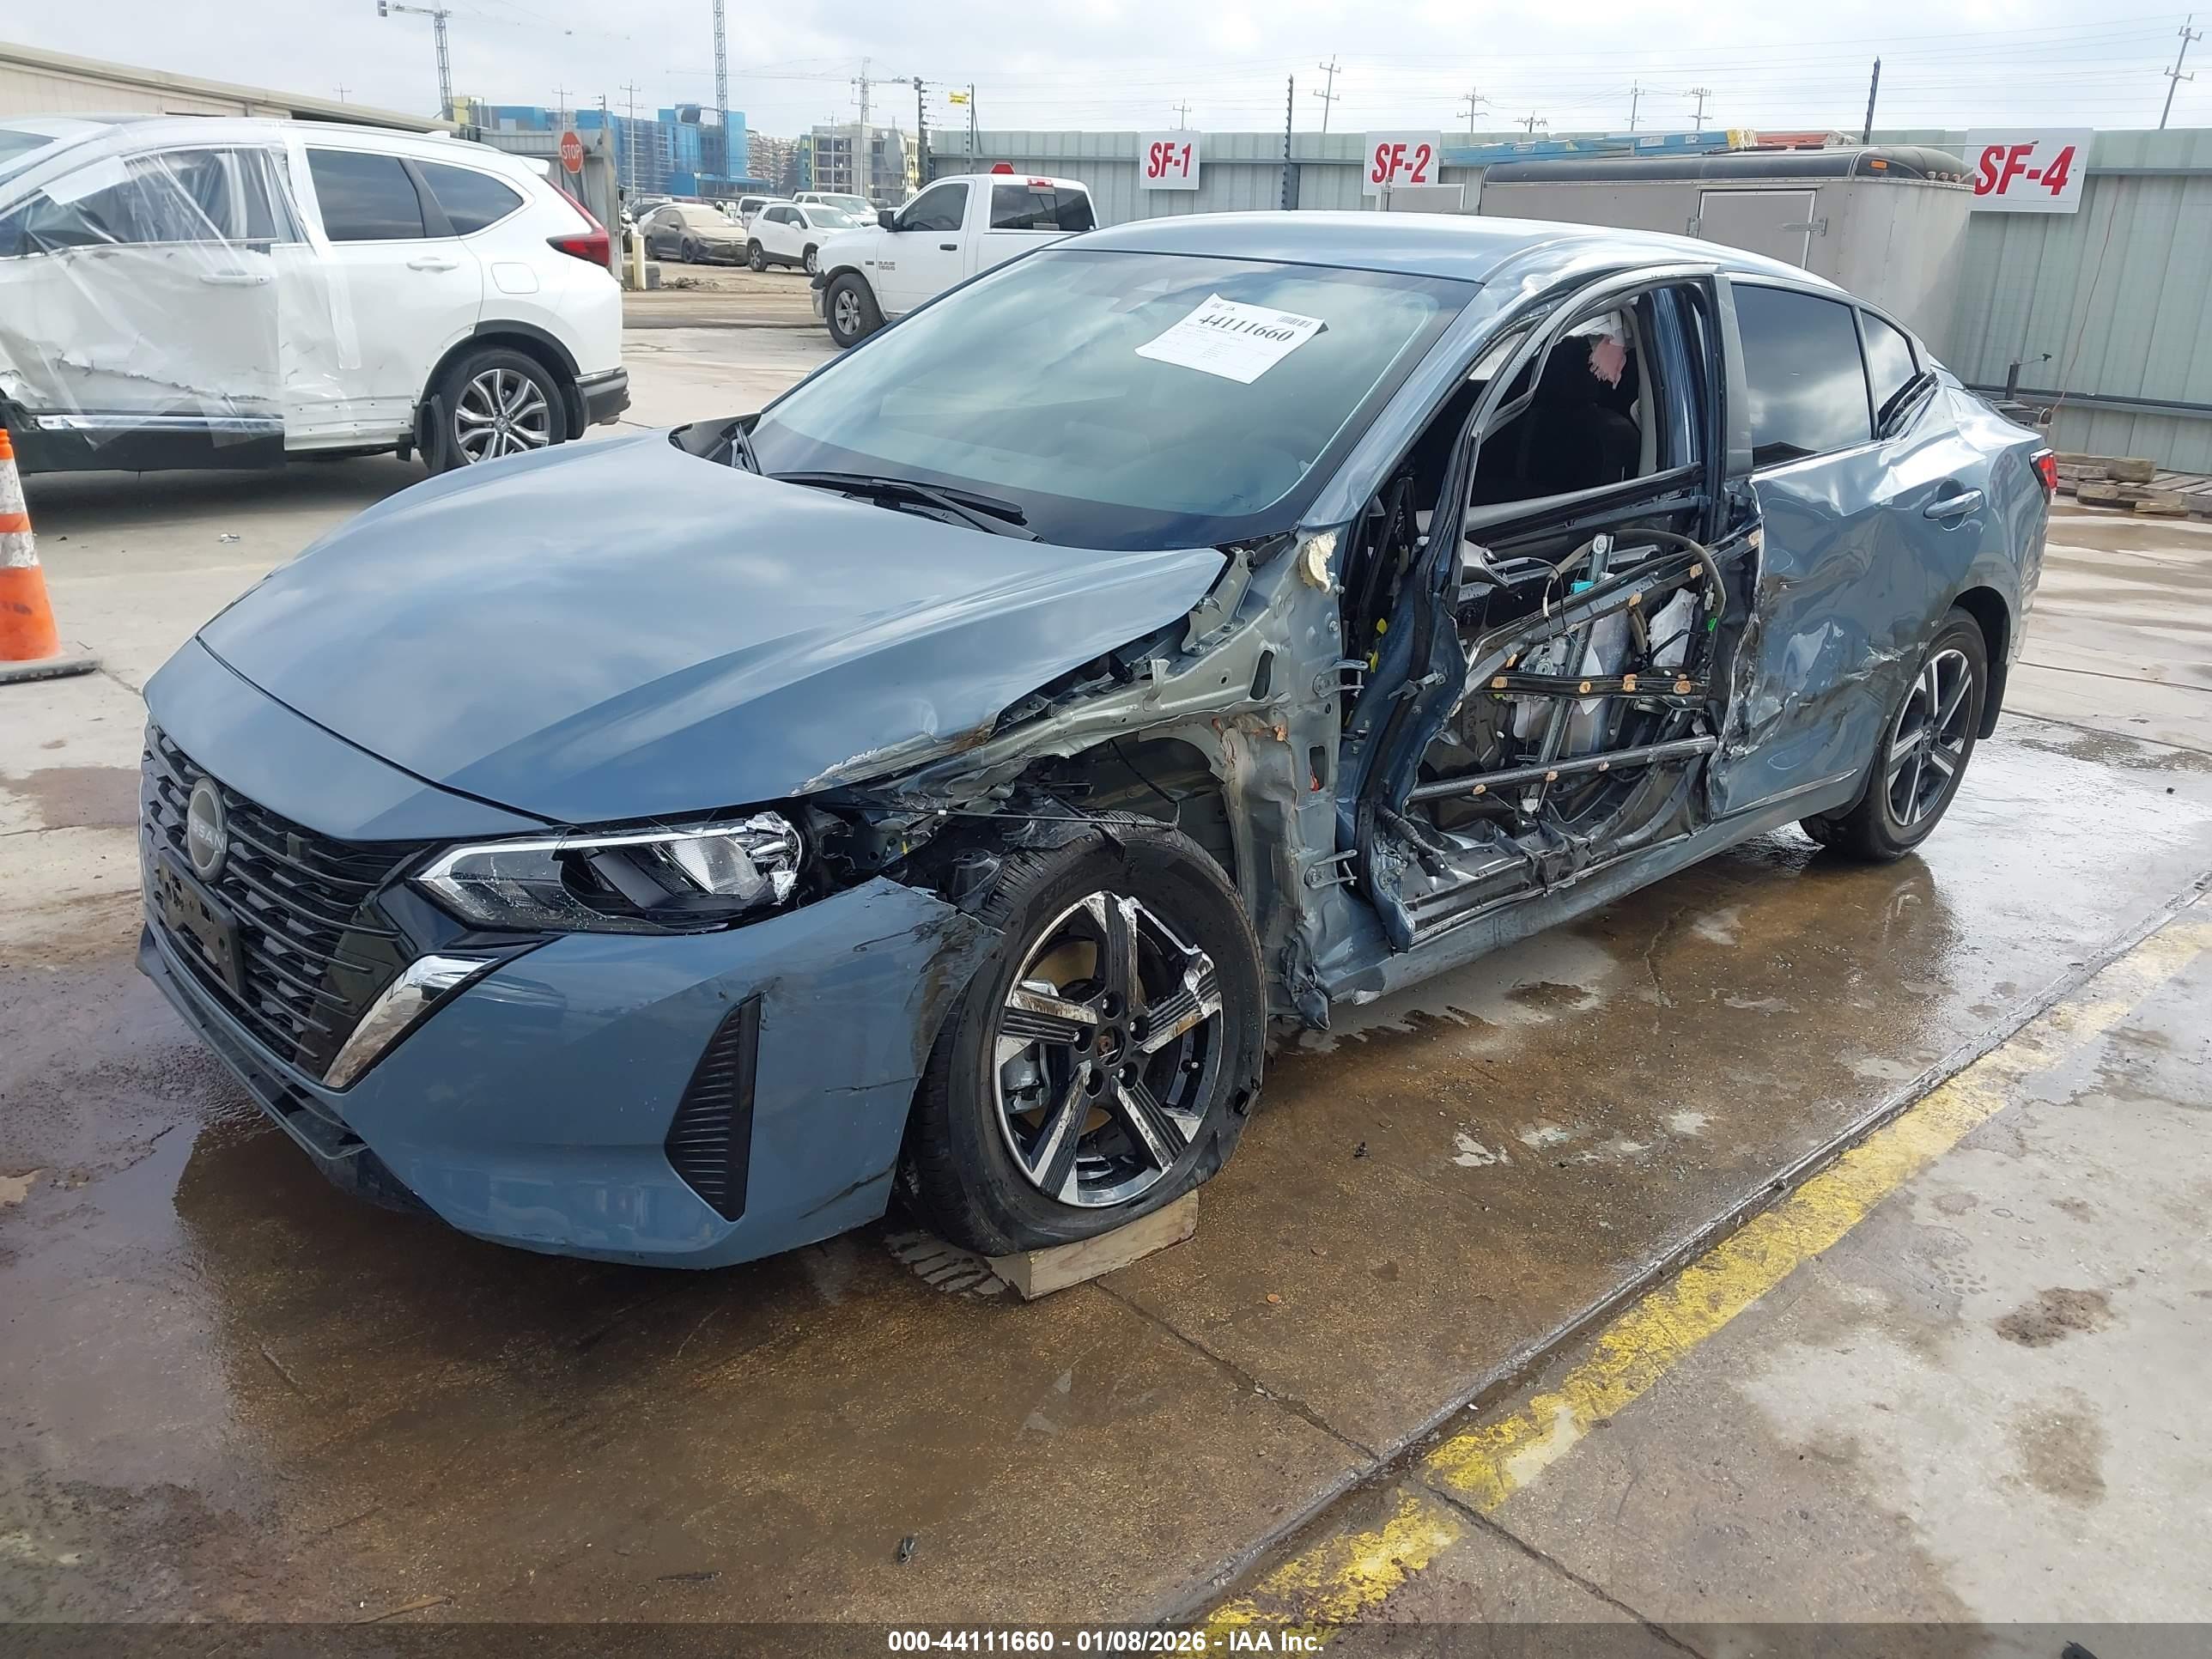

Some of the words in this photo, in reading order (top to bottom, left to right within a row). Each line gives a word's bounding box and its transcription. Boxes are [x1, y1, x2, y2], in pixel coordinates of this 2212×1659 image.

[562, 144, 580, 160] STOP
[1148, 143, 1191, 178] SF-1
[1372, 143, 1431, 184] SF-2
[1974, 145, 2076, 196] SF-4
[1198, 313, 1295, 343] 44111660
